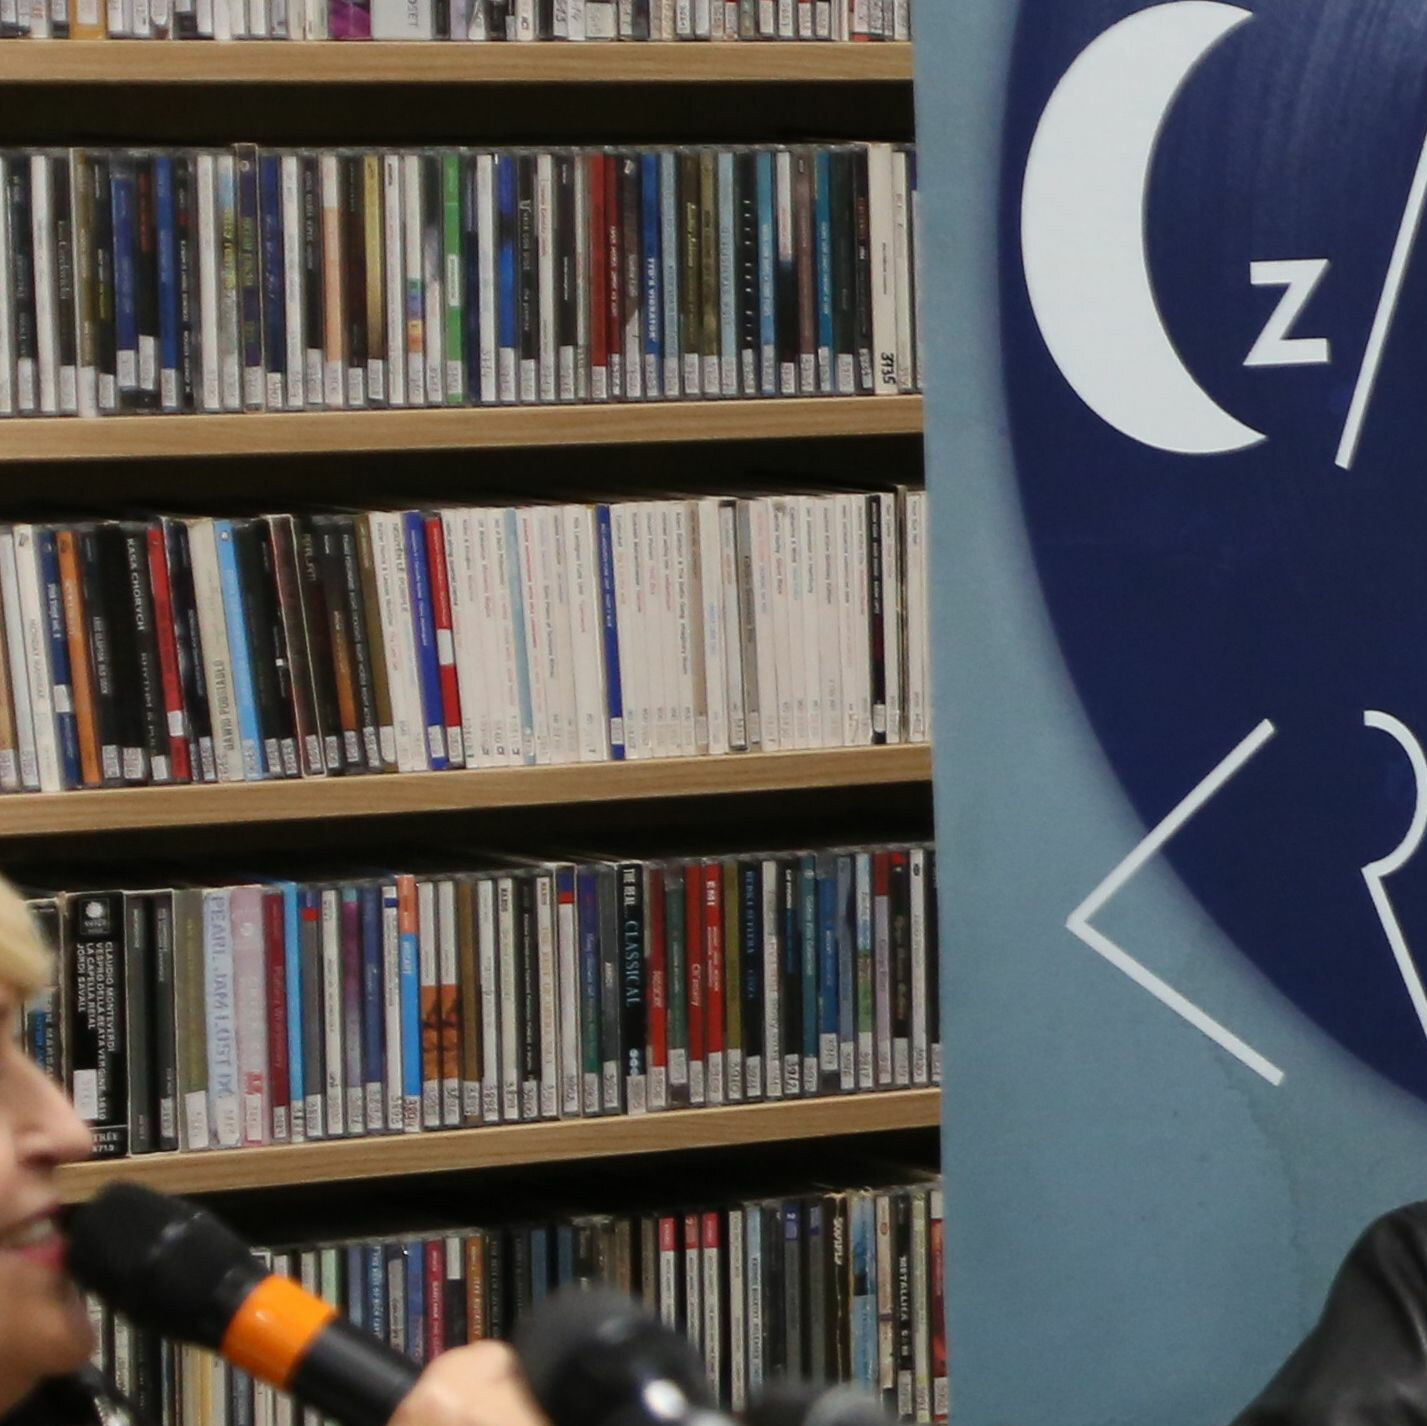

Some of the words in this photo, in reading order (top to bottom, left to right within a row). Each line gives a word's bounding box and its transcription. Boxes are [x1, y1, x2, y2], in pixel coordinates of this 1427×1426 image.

[126, 538, 141, 569] KASA
[623, 868, 636, 883] THE
[706, 881, 716, 906] EMI
[86, 942, 95, 957] LA
[625, 920, 639, 1008] CLASSICAL
[899, 1256, 909, 1321] METALLICA
